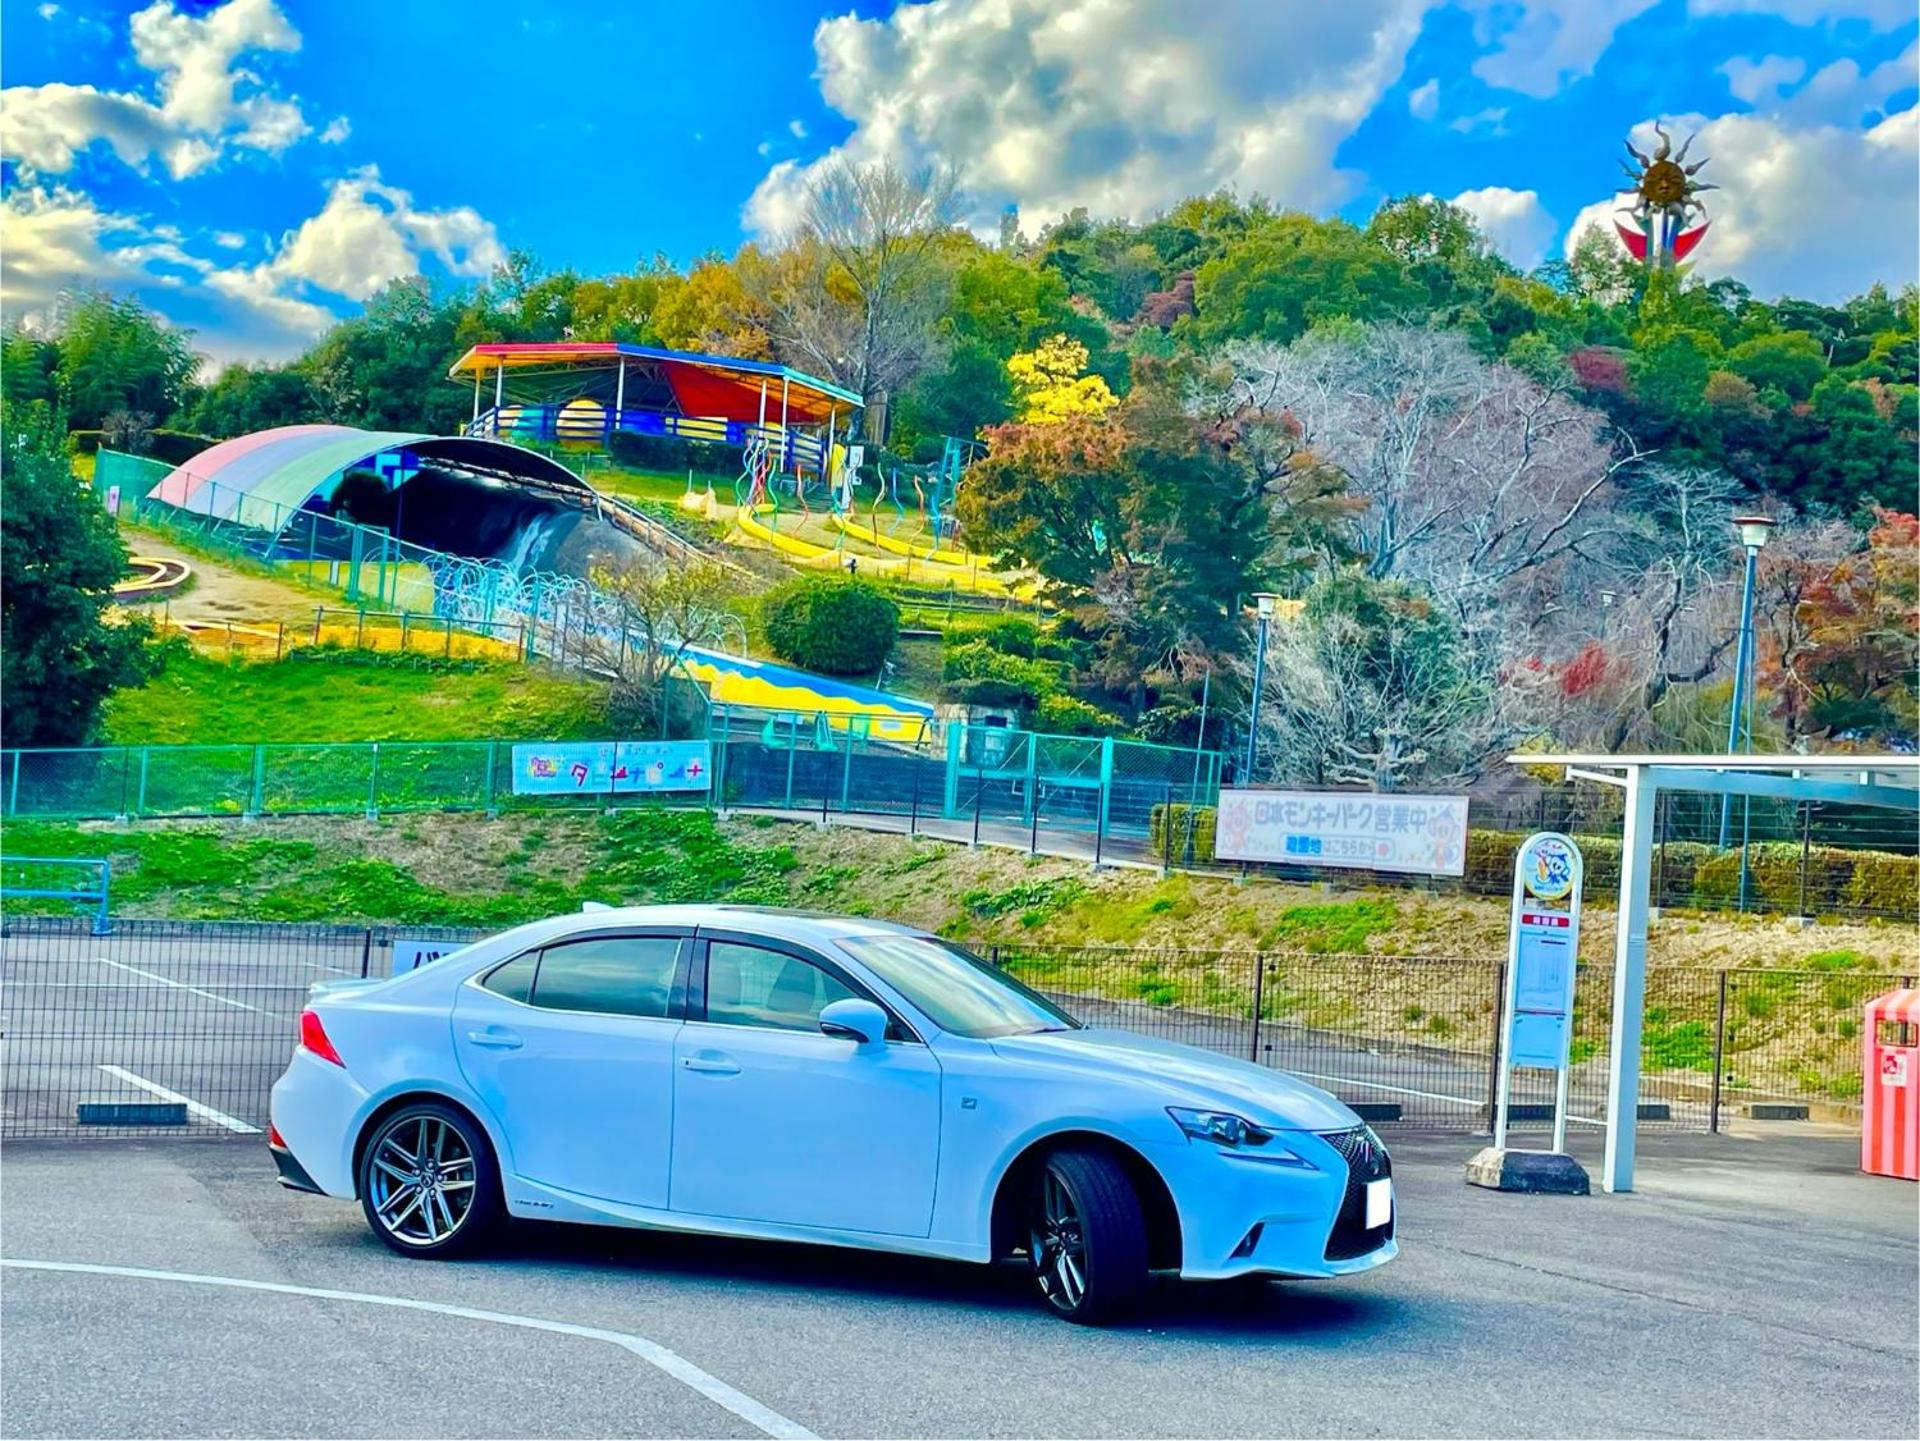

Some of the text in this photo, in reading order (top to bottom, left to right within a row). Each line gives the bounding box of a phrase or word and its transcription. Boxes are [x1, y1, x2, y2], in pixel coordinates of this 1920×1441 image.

[1255, 801, 1427, 833] 日本モンキーパーク営業中
